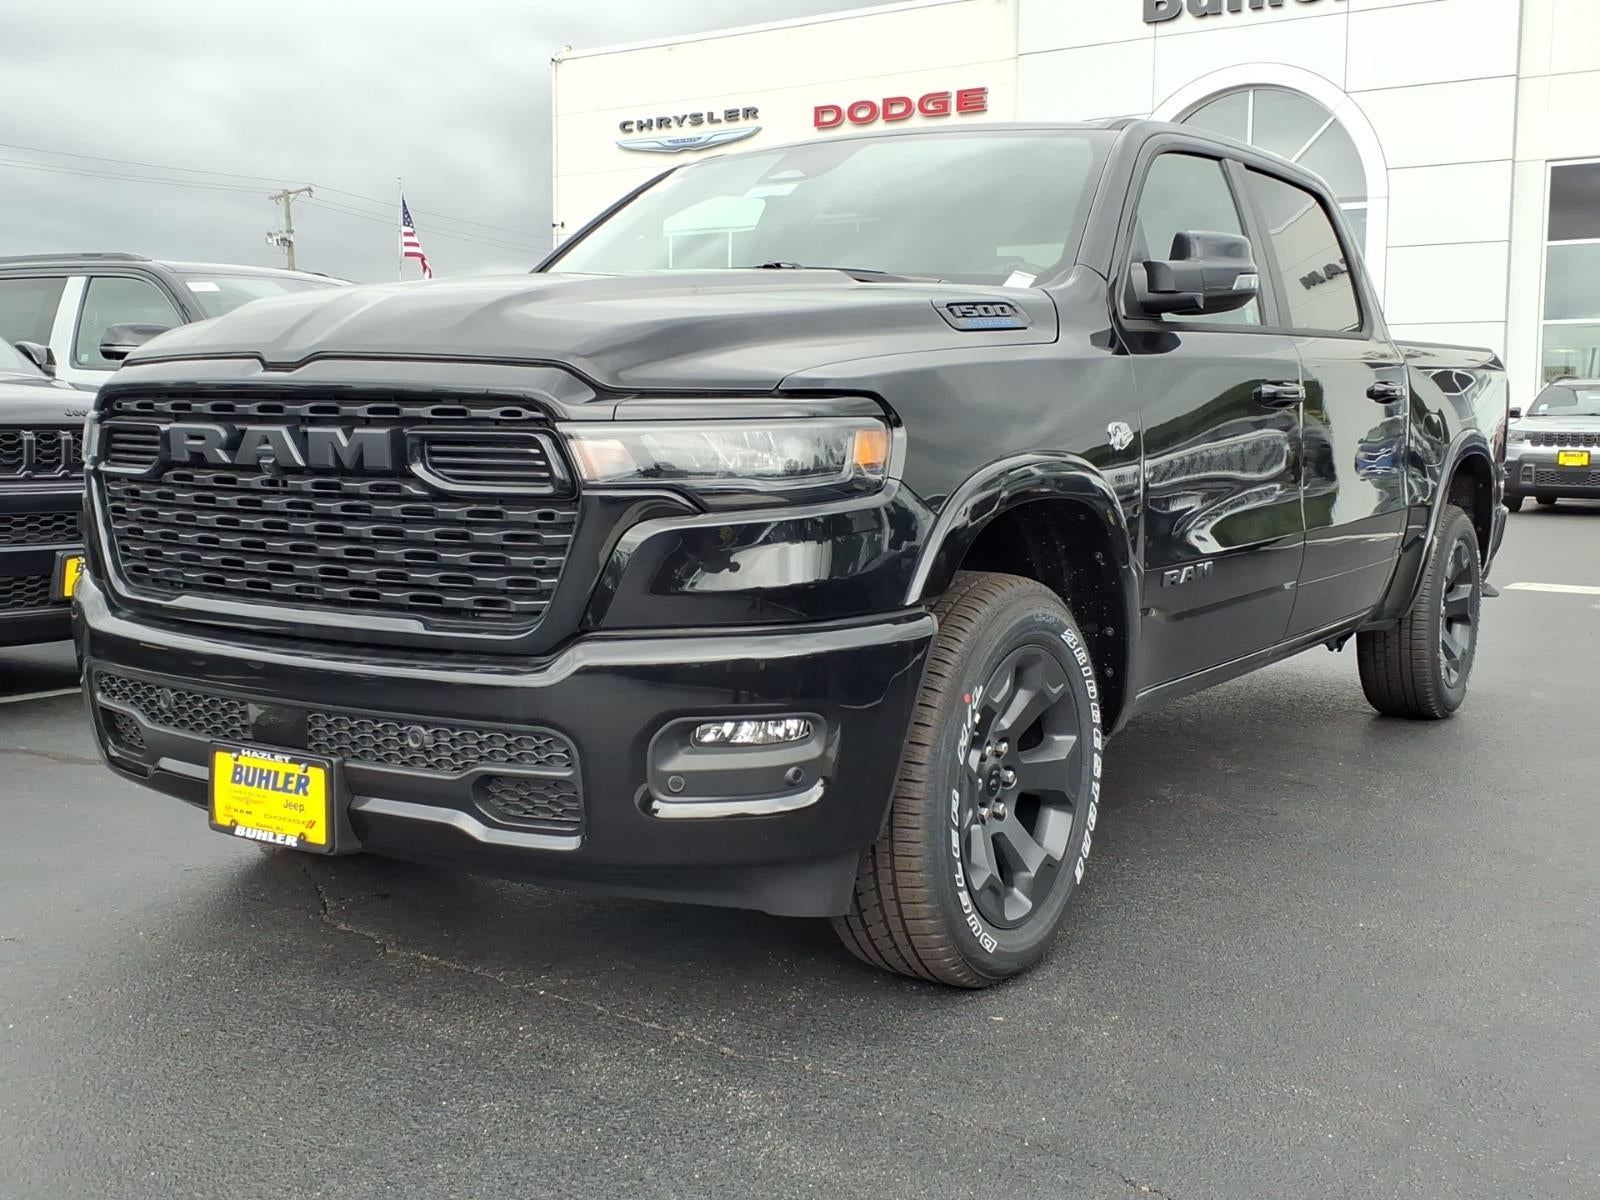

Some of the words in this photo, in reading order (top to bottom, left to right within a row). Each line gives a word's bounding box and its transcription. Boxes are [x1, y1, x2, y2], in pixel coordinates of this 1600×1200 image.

[618, 106, 760, 133] CHRYSLER
[813, 86, 988, 129] DODGE
[948, 304, 1012, 318] 1500
[165, 422, 398, 471] RAM
[1161, 561, 1214, 588] RAM
[241, 748, 292, 764] HAZLET
[230, 763, 311, 797] BUHLER
[283, 799, 305, 813] Jeep
[234, 825, 298, 847] BUHLER
[950, 788, 998, 954] DUELER
